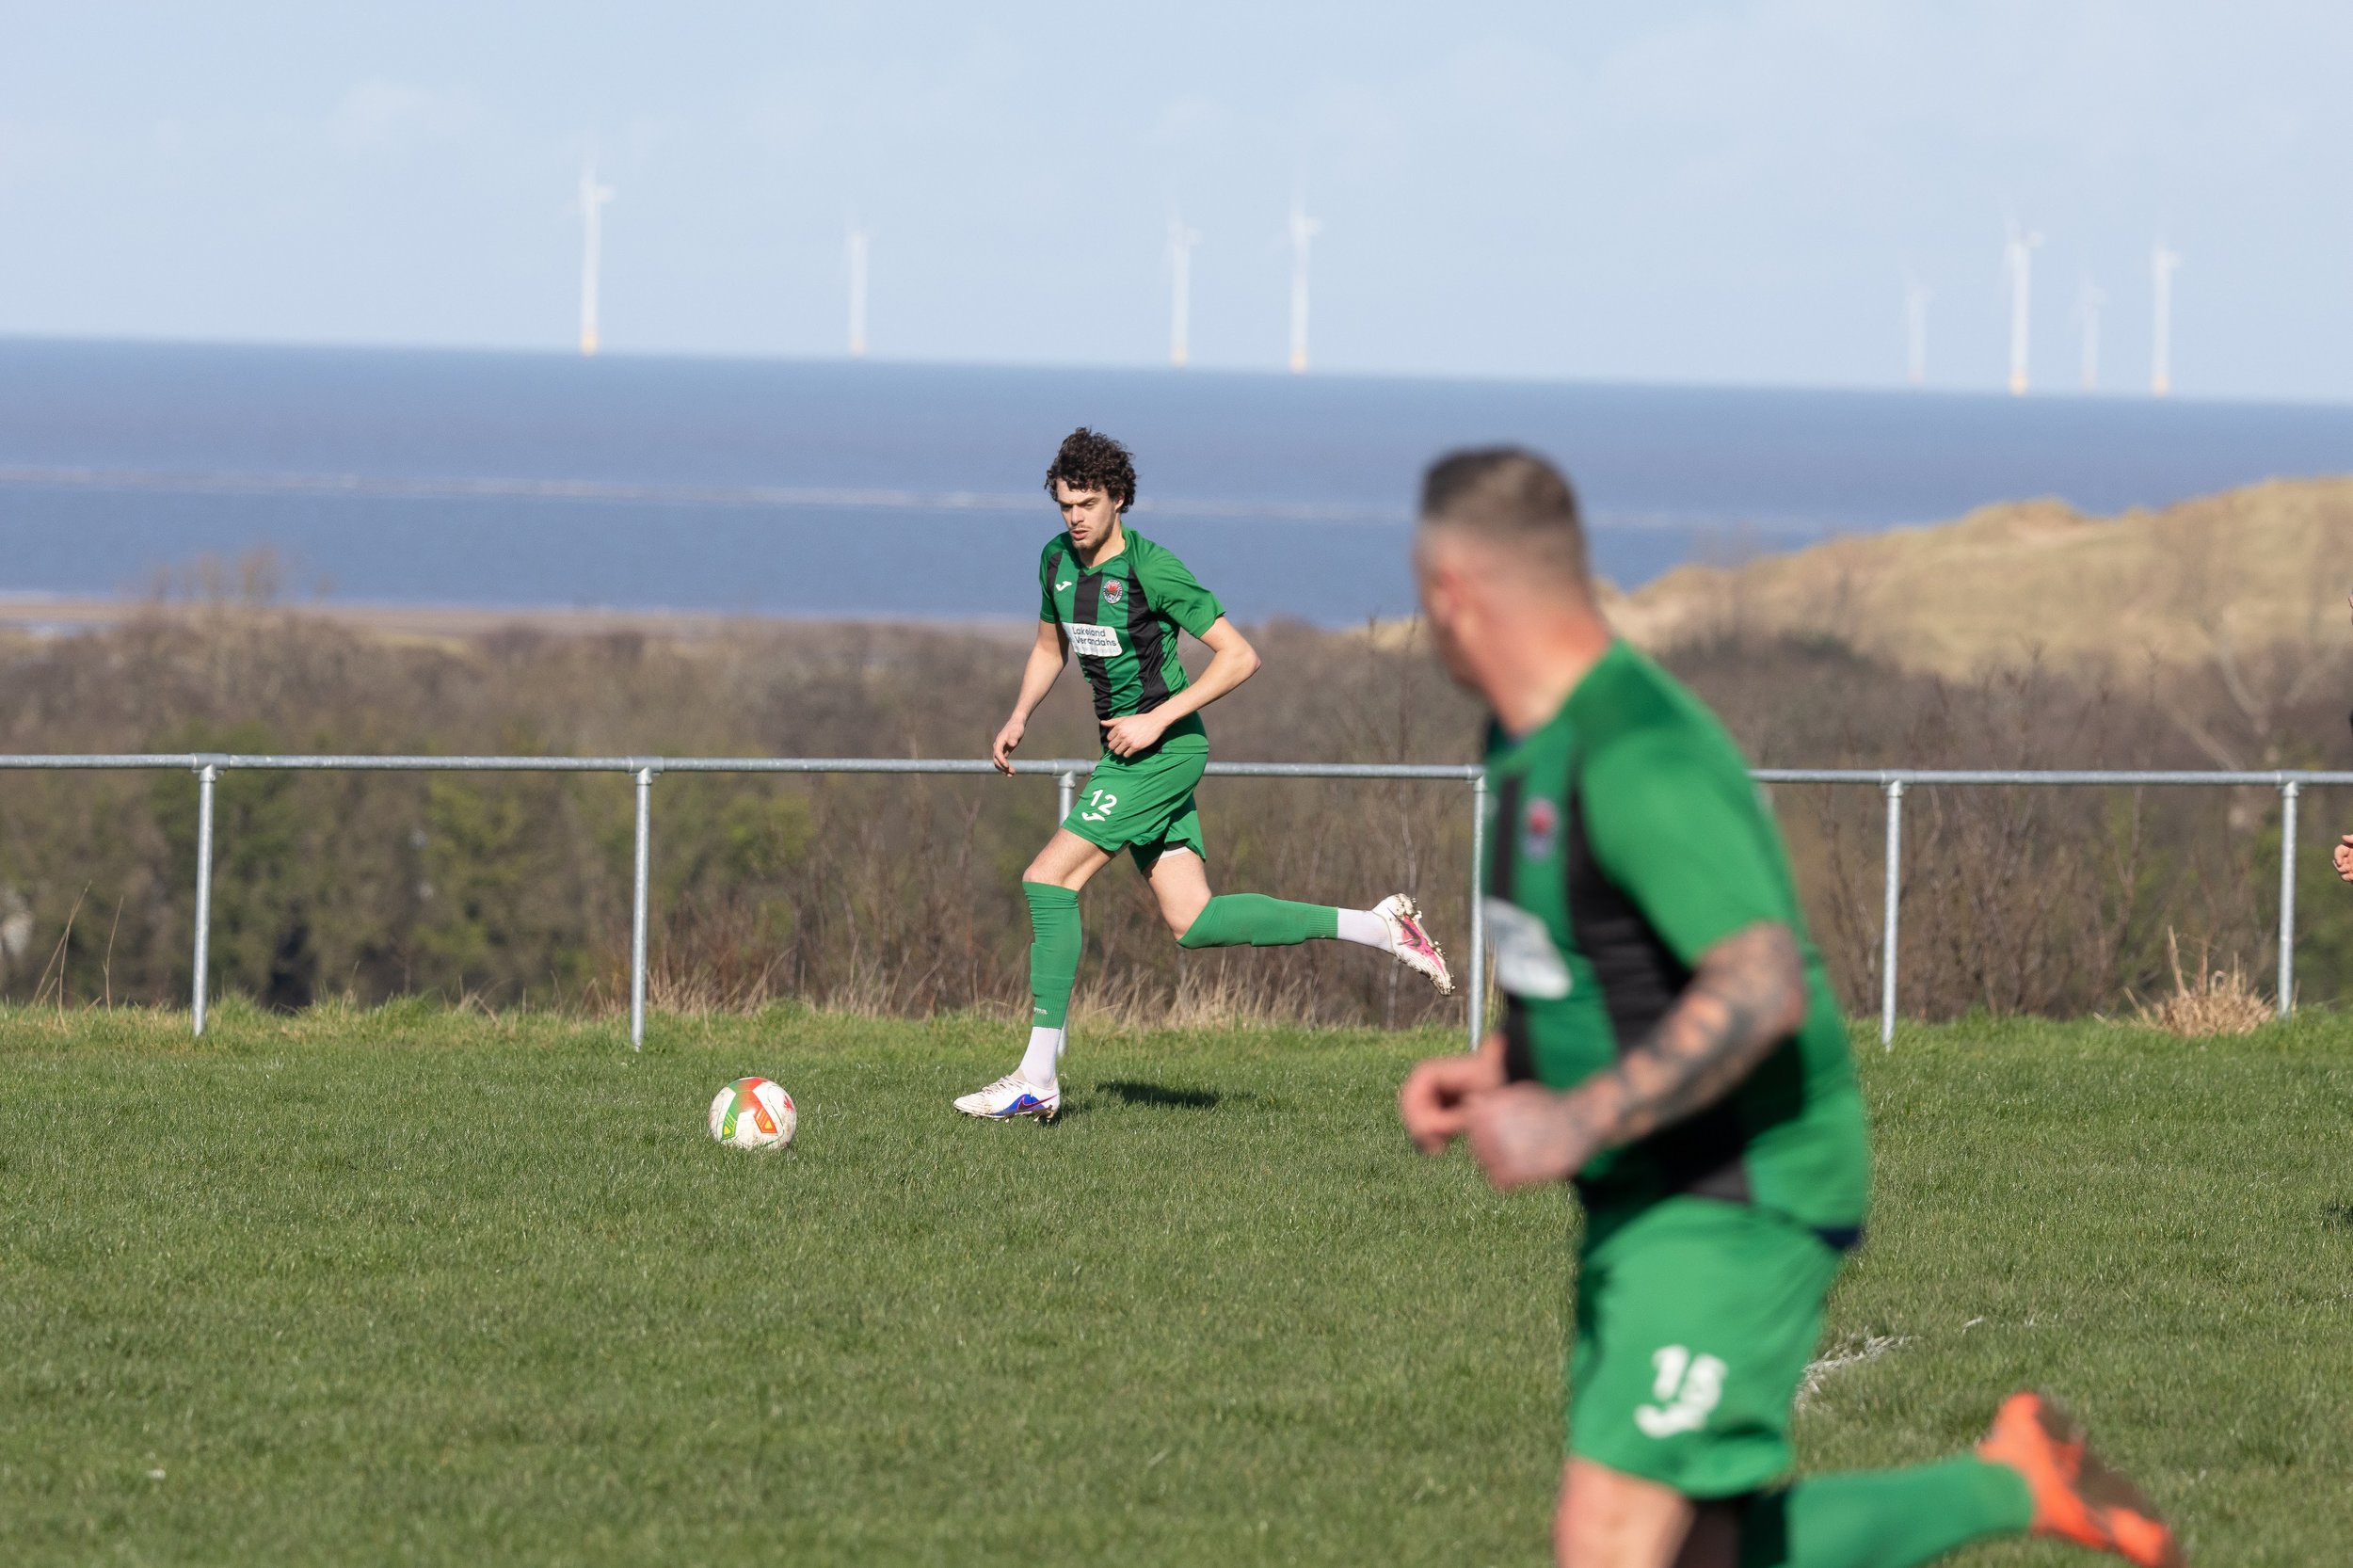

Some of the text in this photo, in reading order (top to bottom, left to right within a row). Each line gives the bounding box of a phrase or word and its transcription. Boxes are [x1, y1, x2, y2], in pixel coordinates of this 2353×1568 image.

[1072, 627, 1106, 637] Lakeland
[1075, 636, 1117, 647] Verandahs
[1090, 789, 1117, 815] 12
